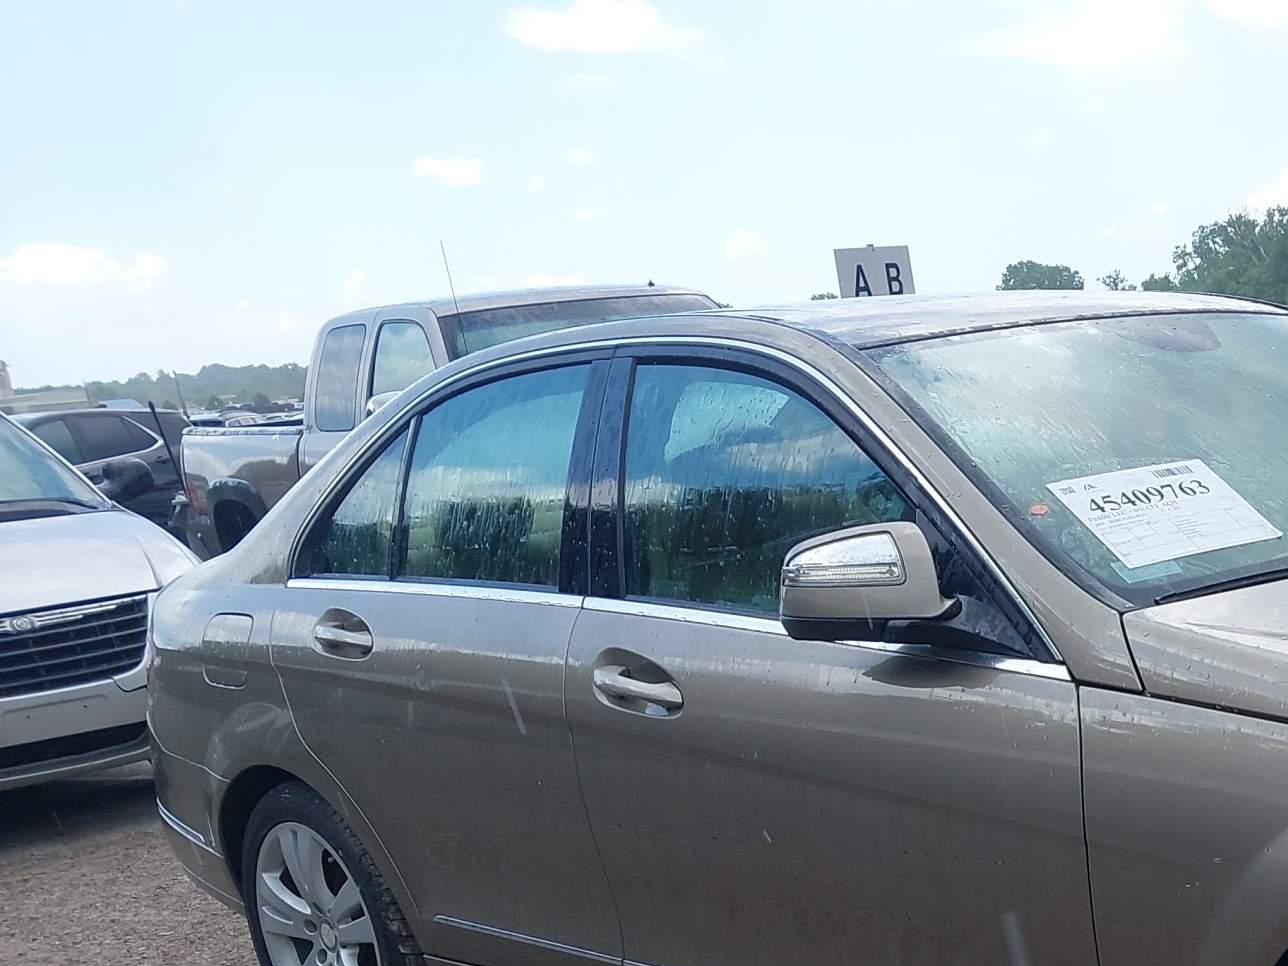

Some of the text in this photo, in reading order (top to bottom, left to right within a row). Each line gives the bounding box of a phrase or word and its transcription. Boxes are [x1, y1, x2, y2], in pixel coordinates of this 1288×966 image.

[855, 262, 904, 297] A B
[1089, 479, 1211, 513] 45409763
